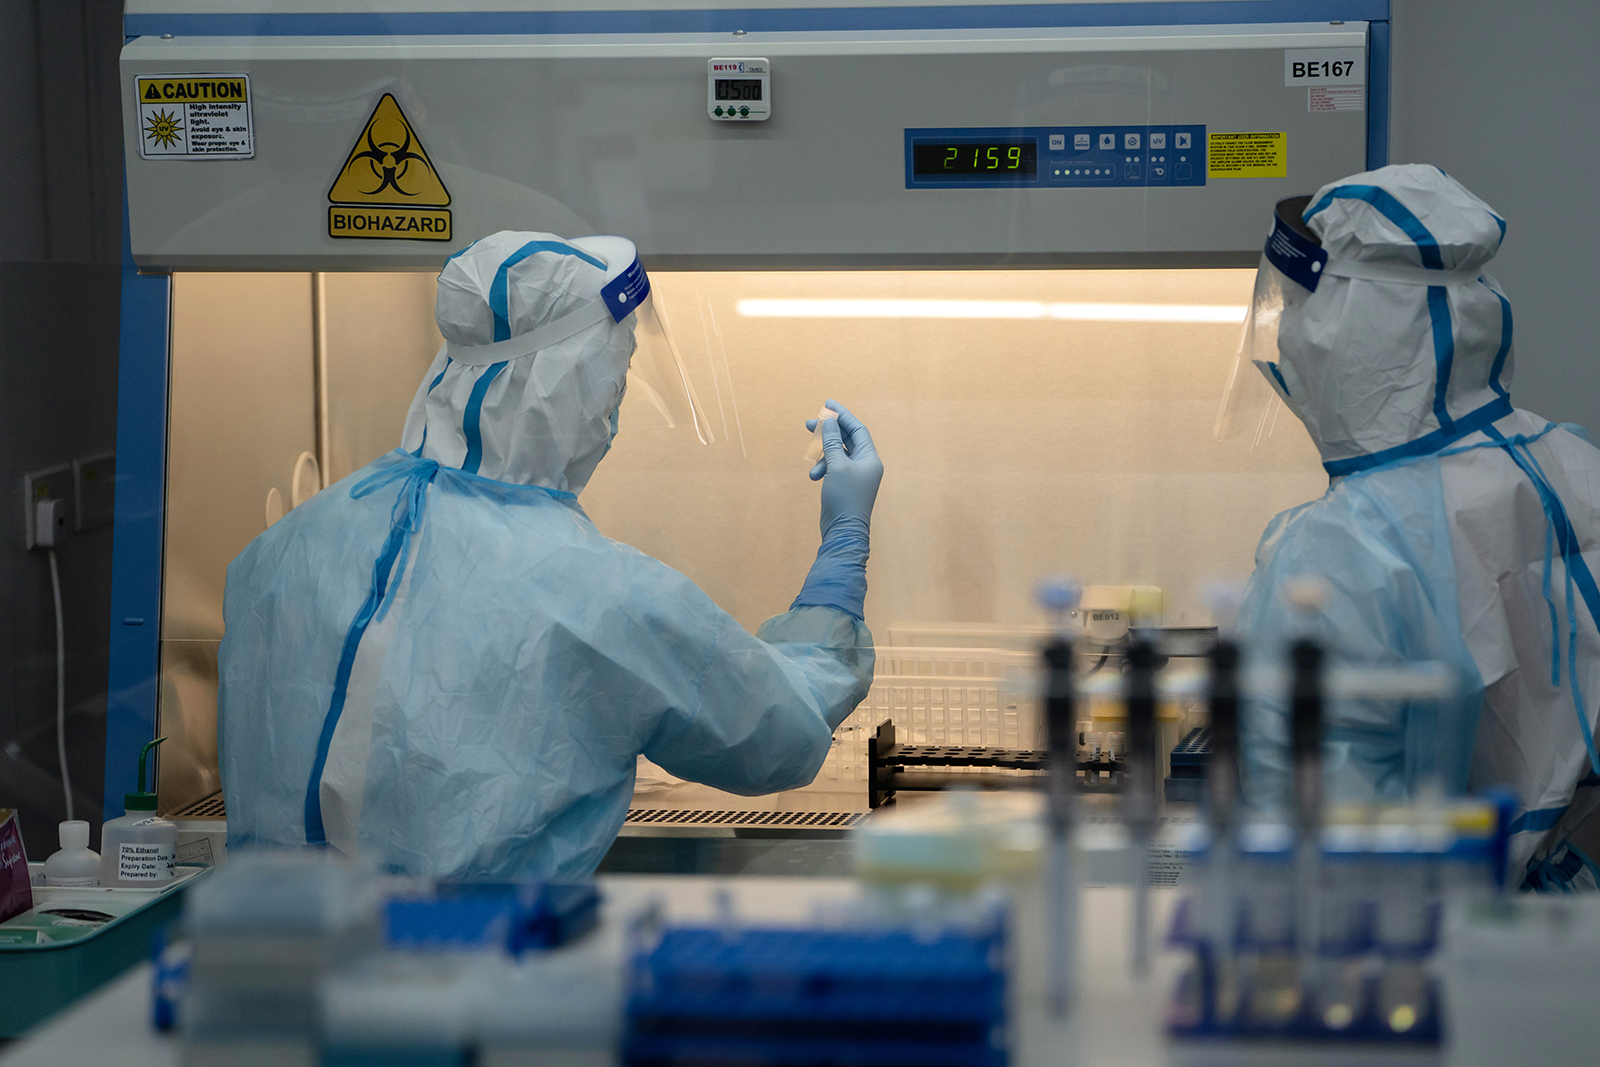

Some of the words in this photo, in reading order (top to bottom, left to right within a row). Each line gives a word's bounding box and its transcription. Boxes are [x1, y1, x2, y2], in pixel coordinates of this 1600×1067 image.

[1292, 60, 1355, 78] BE167
[162, 82, 242, 99] CAUTION
[190, 118, 210, 126] light.
[943, 146, 1021, 169] 2159
[333, 214, 447, 233] BIOHAZARD
[1092, 612, 1120, 621] BE012
[121, 854, 156, 862] Preparation
[120, 862, 141, 870] Expiry
[120, 870, 149, 878] Prepared
[149, 871, 158, 879] by:
